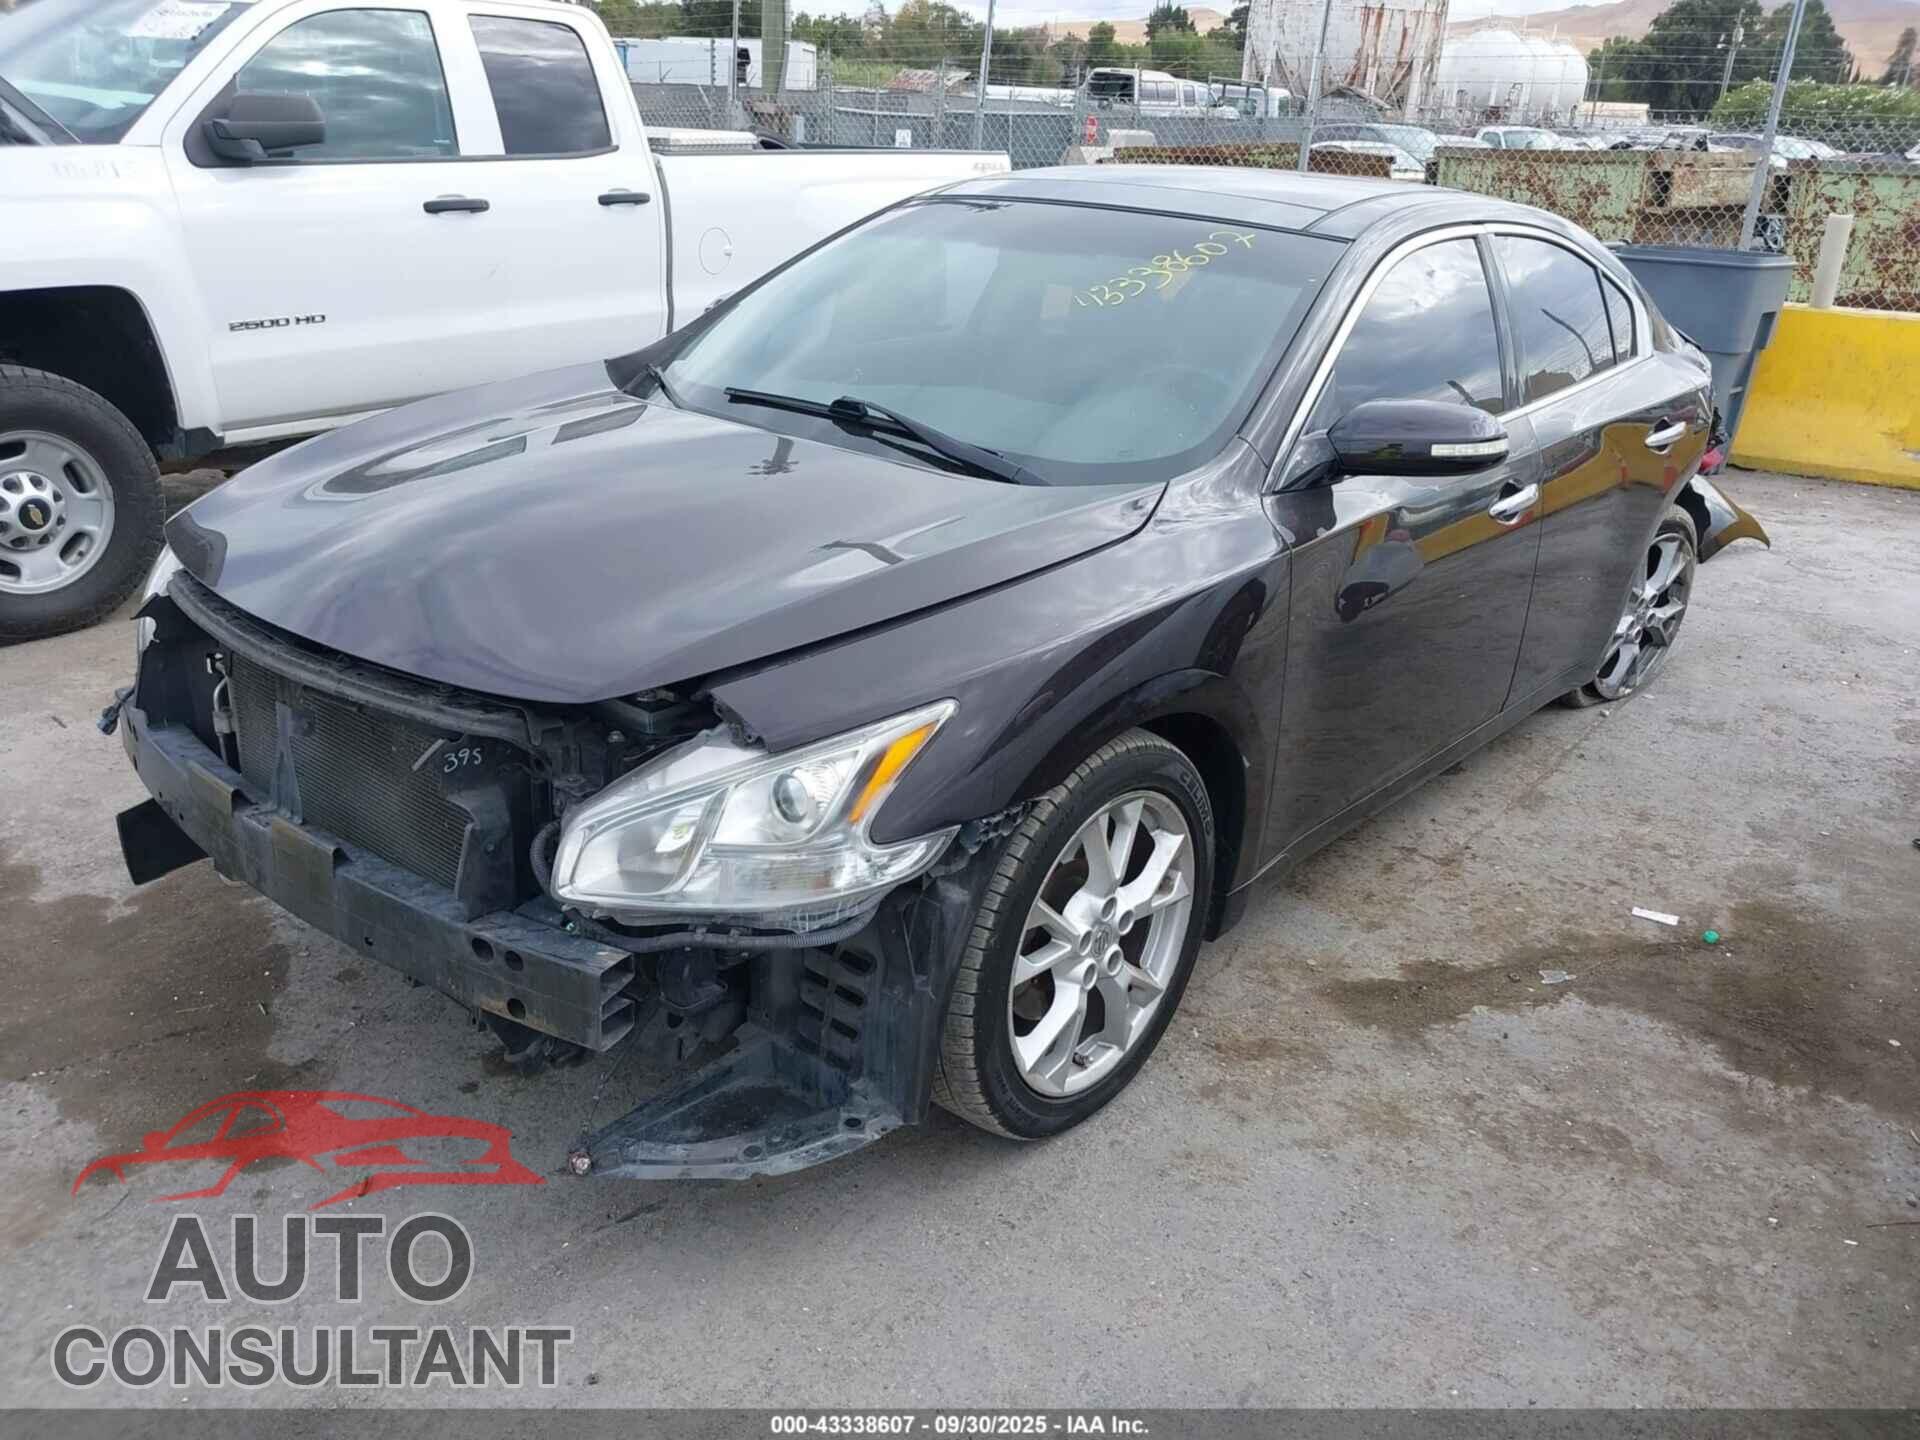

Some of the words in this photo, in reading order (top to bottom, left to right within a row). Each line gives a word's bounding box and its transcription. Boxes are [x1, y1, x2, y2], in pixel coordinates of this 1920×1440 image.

[1074, 231, 1255, 306] 43338607
[229, 318, 290, 331] 2500
[295, 315, 325, 325] HD
[444, 747, 482, 773] 395
